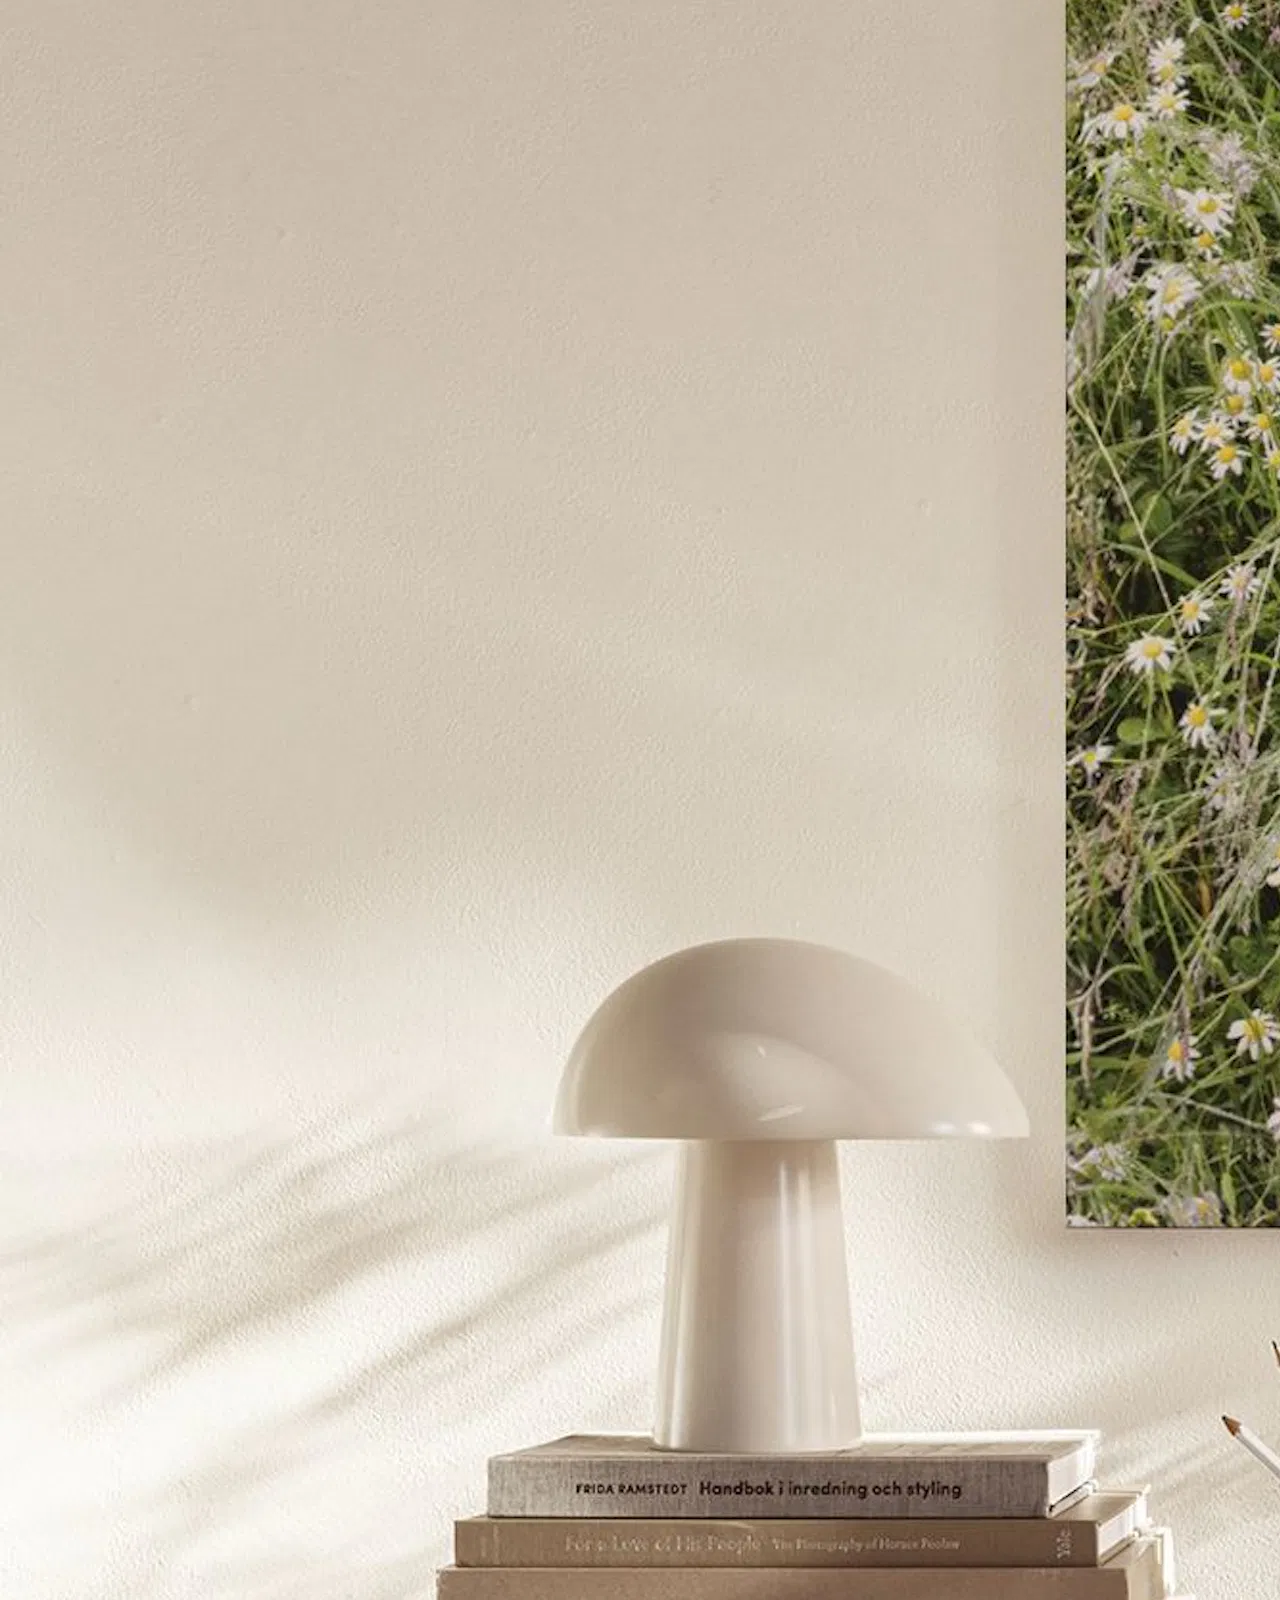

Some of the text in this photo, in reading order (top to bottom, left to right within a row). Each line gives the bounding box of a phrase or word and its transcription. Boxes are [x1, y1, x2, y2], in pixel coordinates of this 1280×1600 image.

[575, 1480, 962, 1500] FRIDA RAMSTEDT Handbok i inredning och styling
